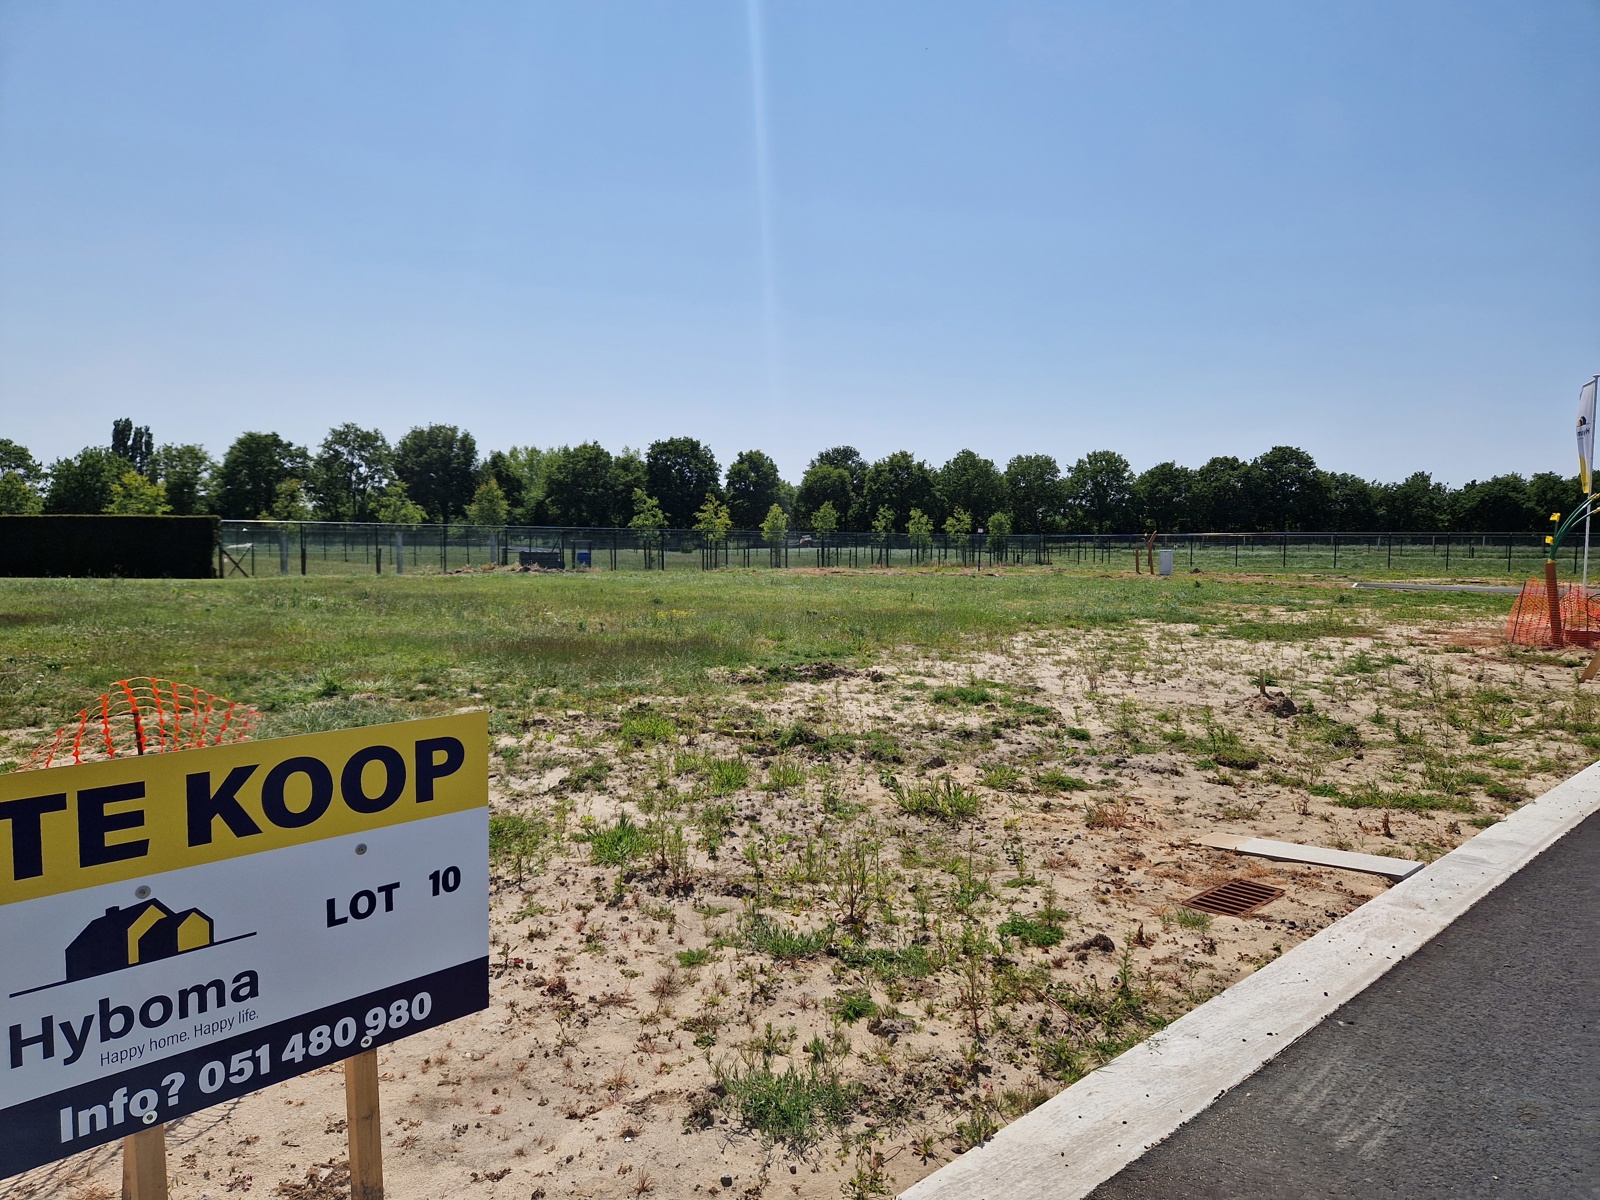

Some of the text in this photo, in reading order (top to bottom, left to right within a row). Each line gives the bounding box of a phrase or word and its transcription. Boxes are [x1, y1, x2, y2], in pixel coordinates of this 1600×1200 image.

[0, 737, 465, 881] TE KOOP
[326, 866, 461, 928] LOT 10
[9, 969, 259, 1069] Hyboma
[60, 992, 432, 1144] Info? 051 480 980
[100, 1008, 259, 1066] Happy home. Happy life.
